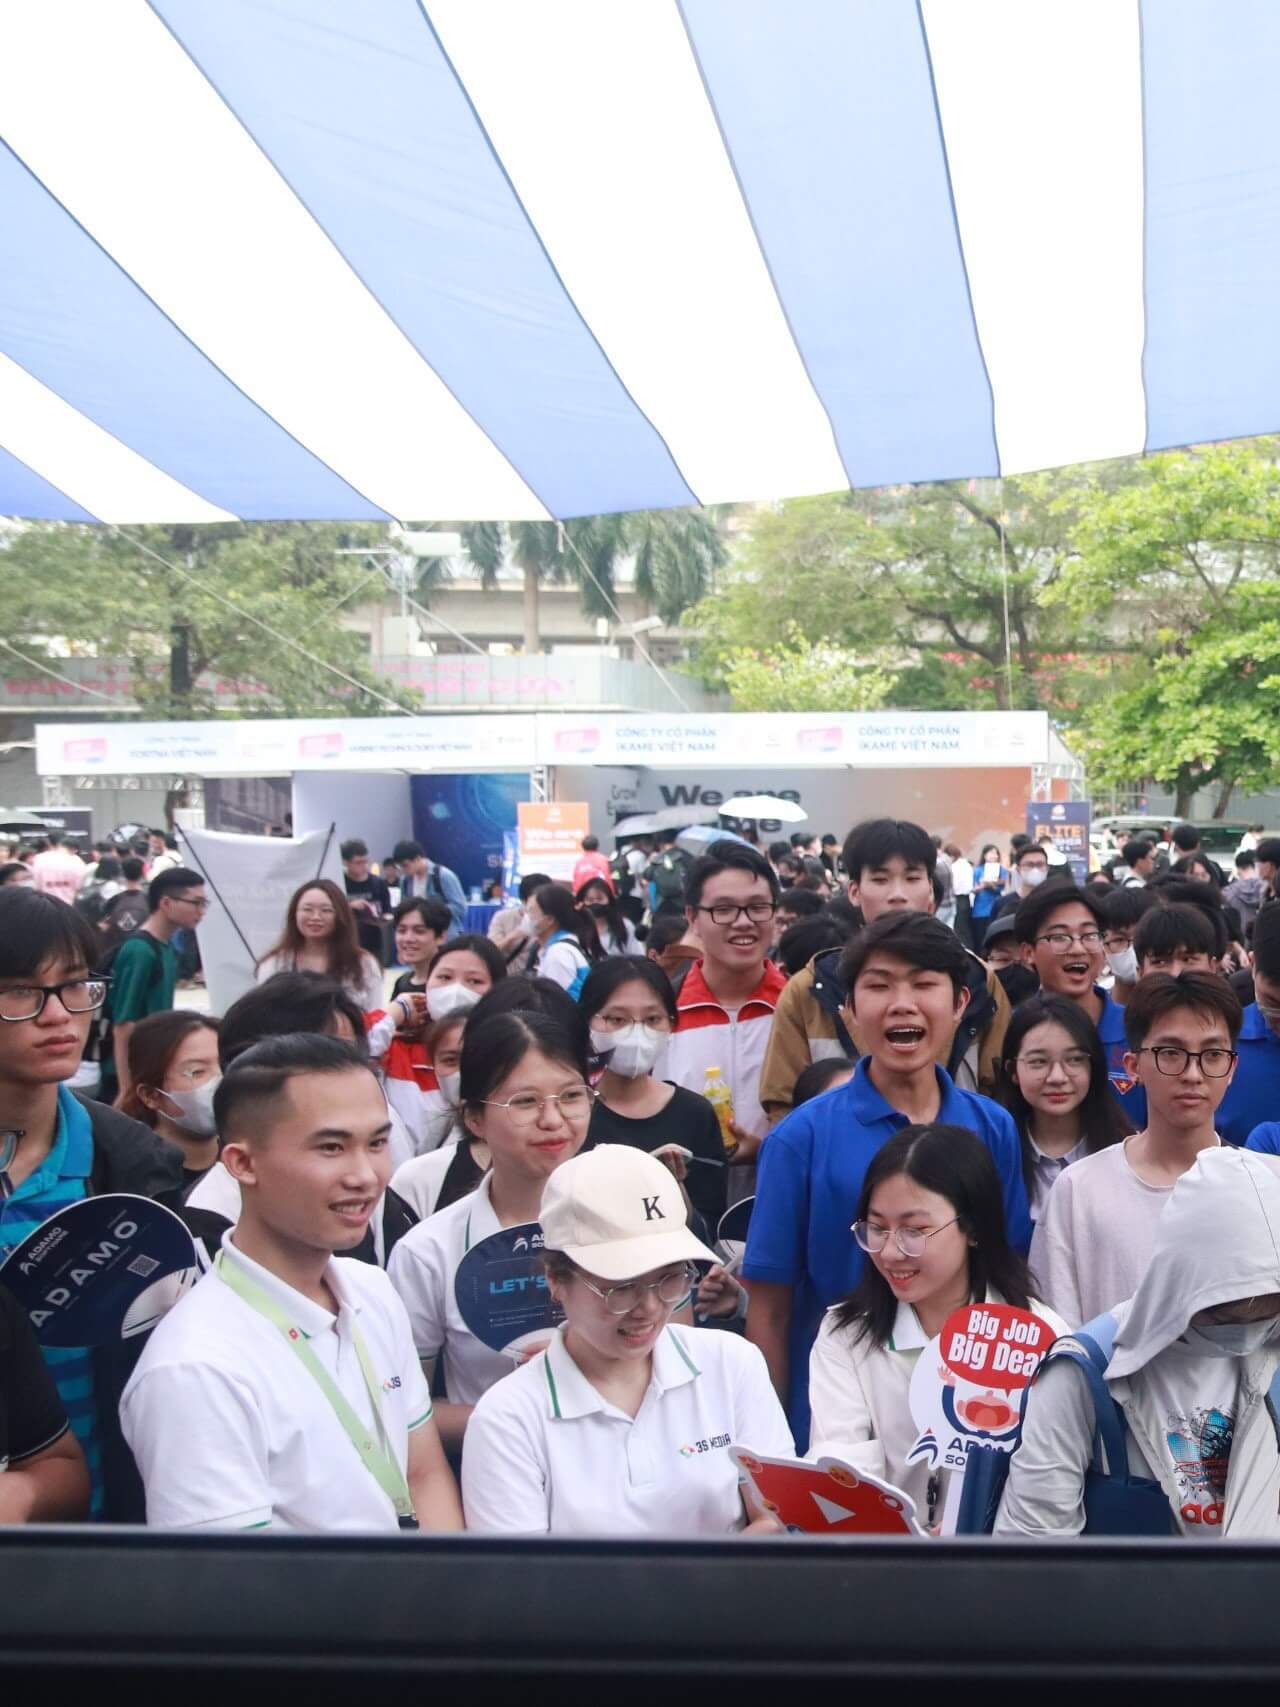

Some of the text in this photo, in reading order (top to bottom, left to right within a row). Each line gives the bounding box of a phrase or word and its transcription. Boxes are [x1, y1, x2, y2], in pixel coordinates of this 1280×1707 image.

[615, 726, 649, 738] CÔNG
[651, 728, 664, 737] TY
[858, 724, 891, 736] CÔNG
[893, 727, 906, 736] TY
[687, 743, 716, 752] NAM
[931, 741, 960, 750] NAM
[659, 784, 723, 806] We
[641, 1195, 667, 1223] K
[28, 1226, 62, 1260] ADAMO
[29, 1220, 139, 1329] ADAMO
[489, 1274, 547, 1296] LET'S
[967, 1309, 1041, 1347] Big Job
[948, 1332, 990, 1371] Big
